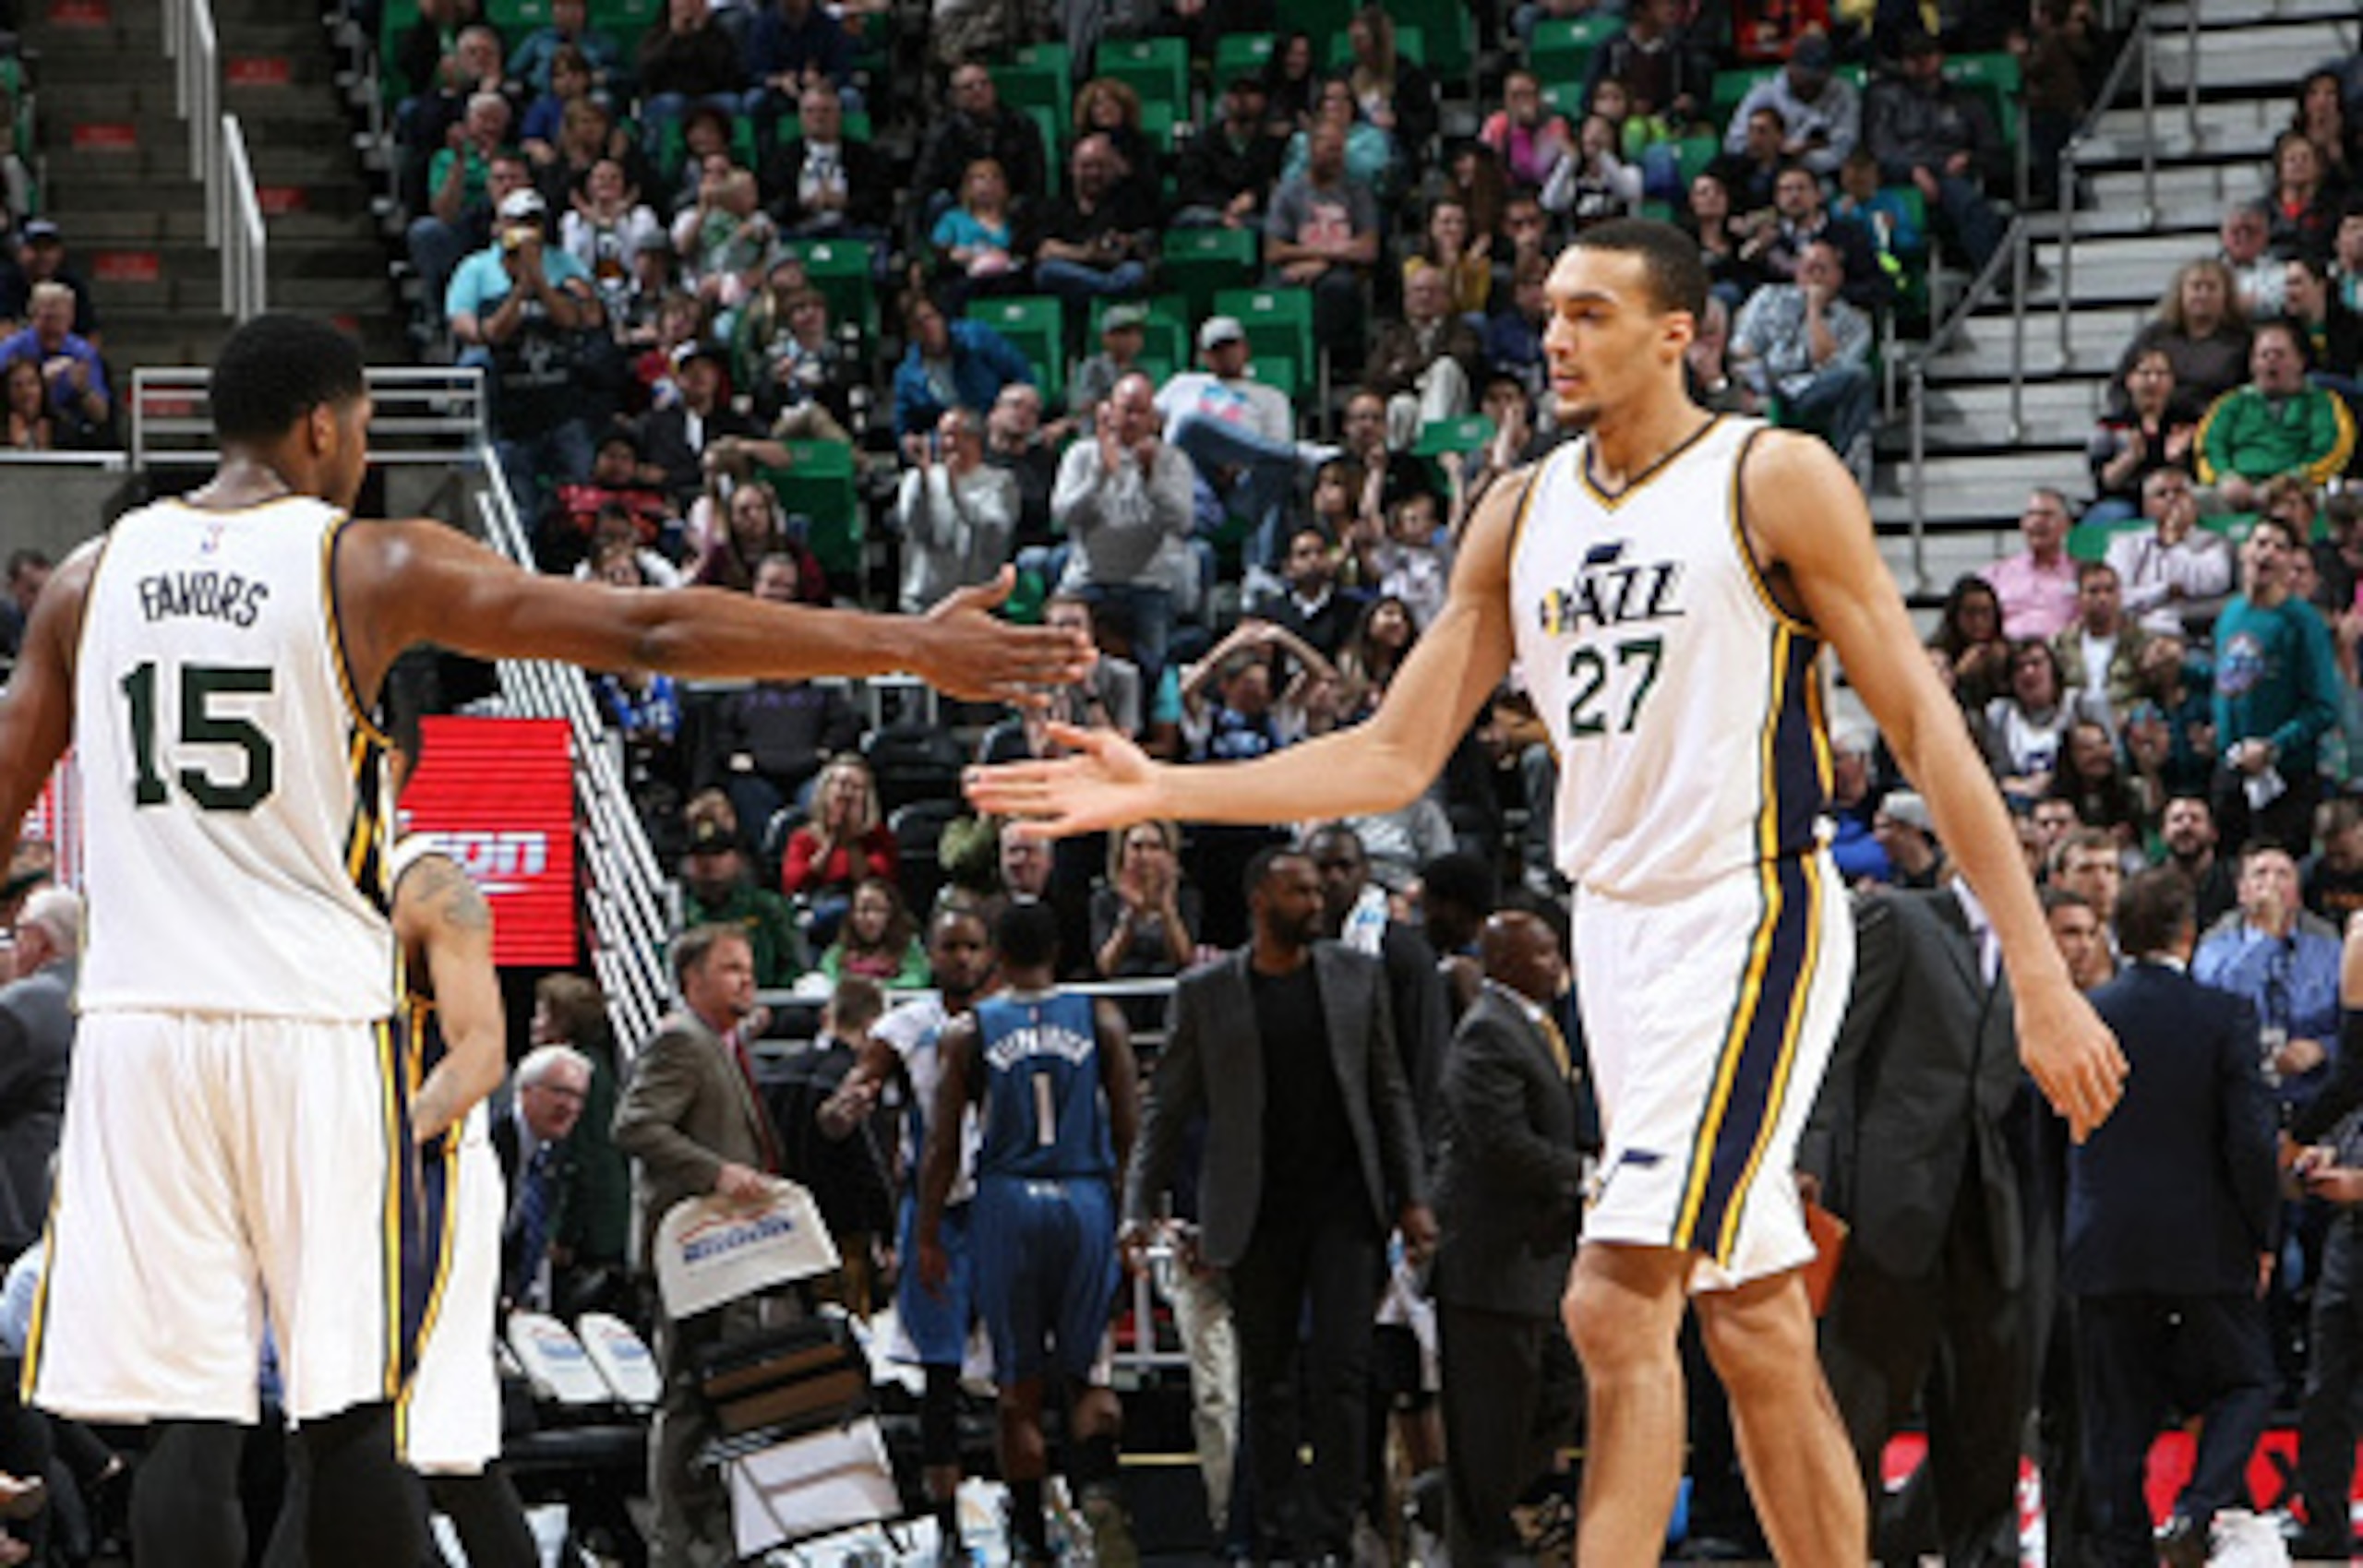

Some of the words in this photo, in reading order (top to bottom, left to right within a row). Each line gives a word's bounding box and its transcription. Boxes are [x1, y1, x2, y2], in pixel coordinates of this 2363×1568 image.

[138, 571, 270, 628] FAVORS
[1569, 633, 1662, 736] 27
[119, 660, 274, 810] 15
[1032, 1071, 1057, 1147] 1
